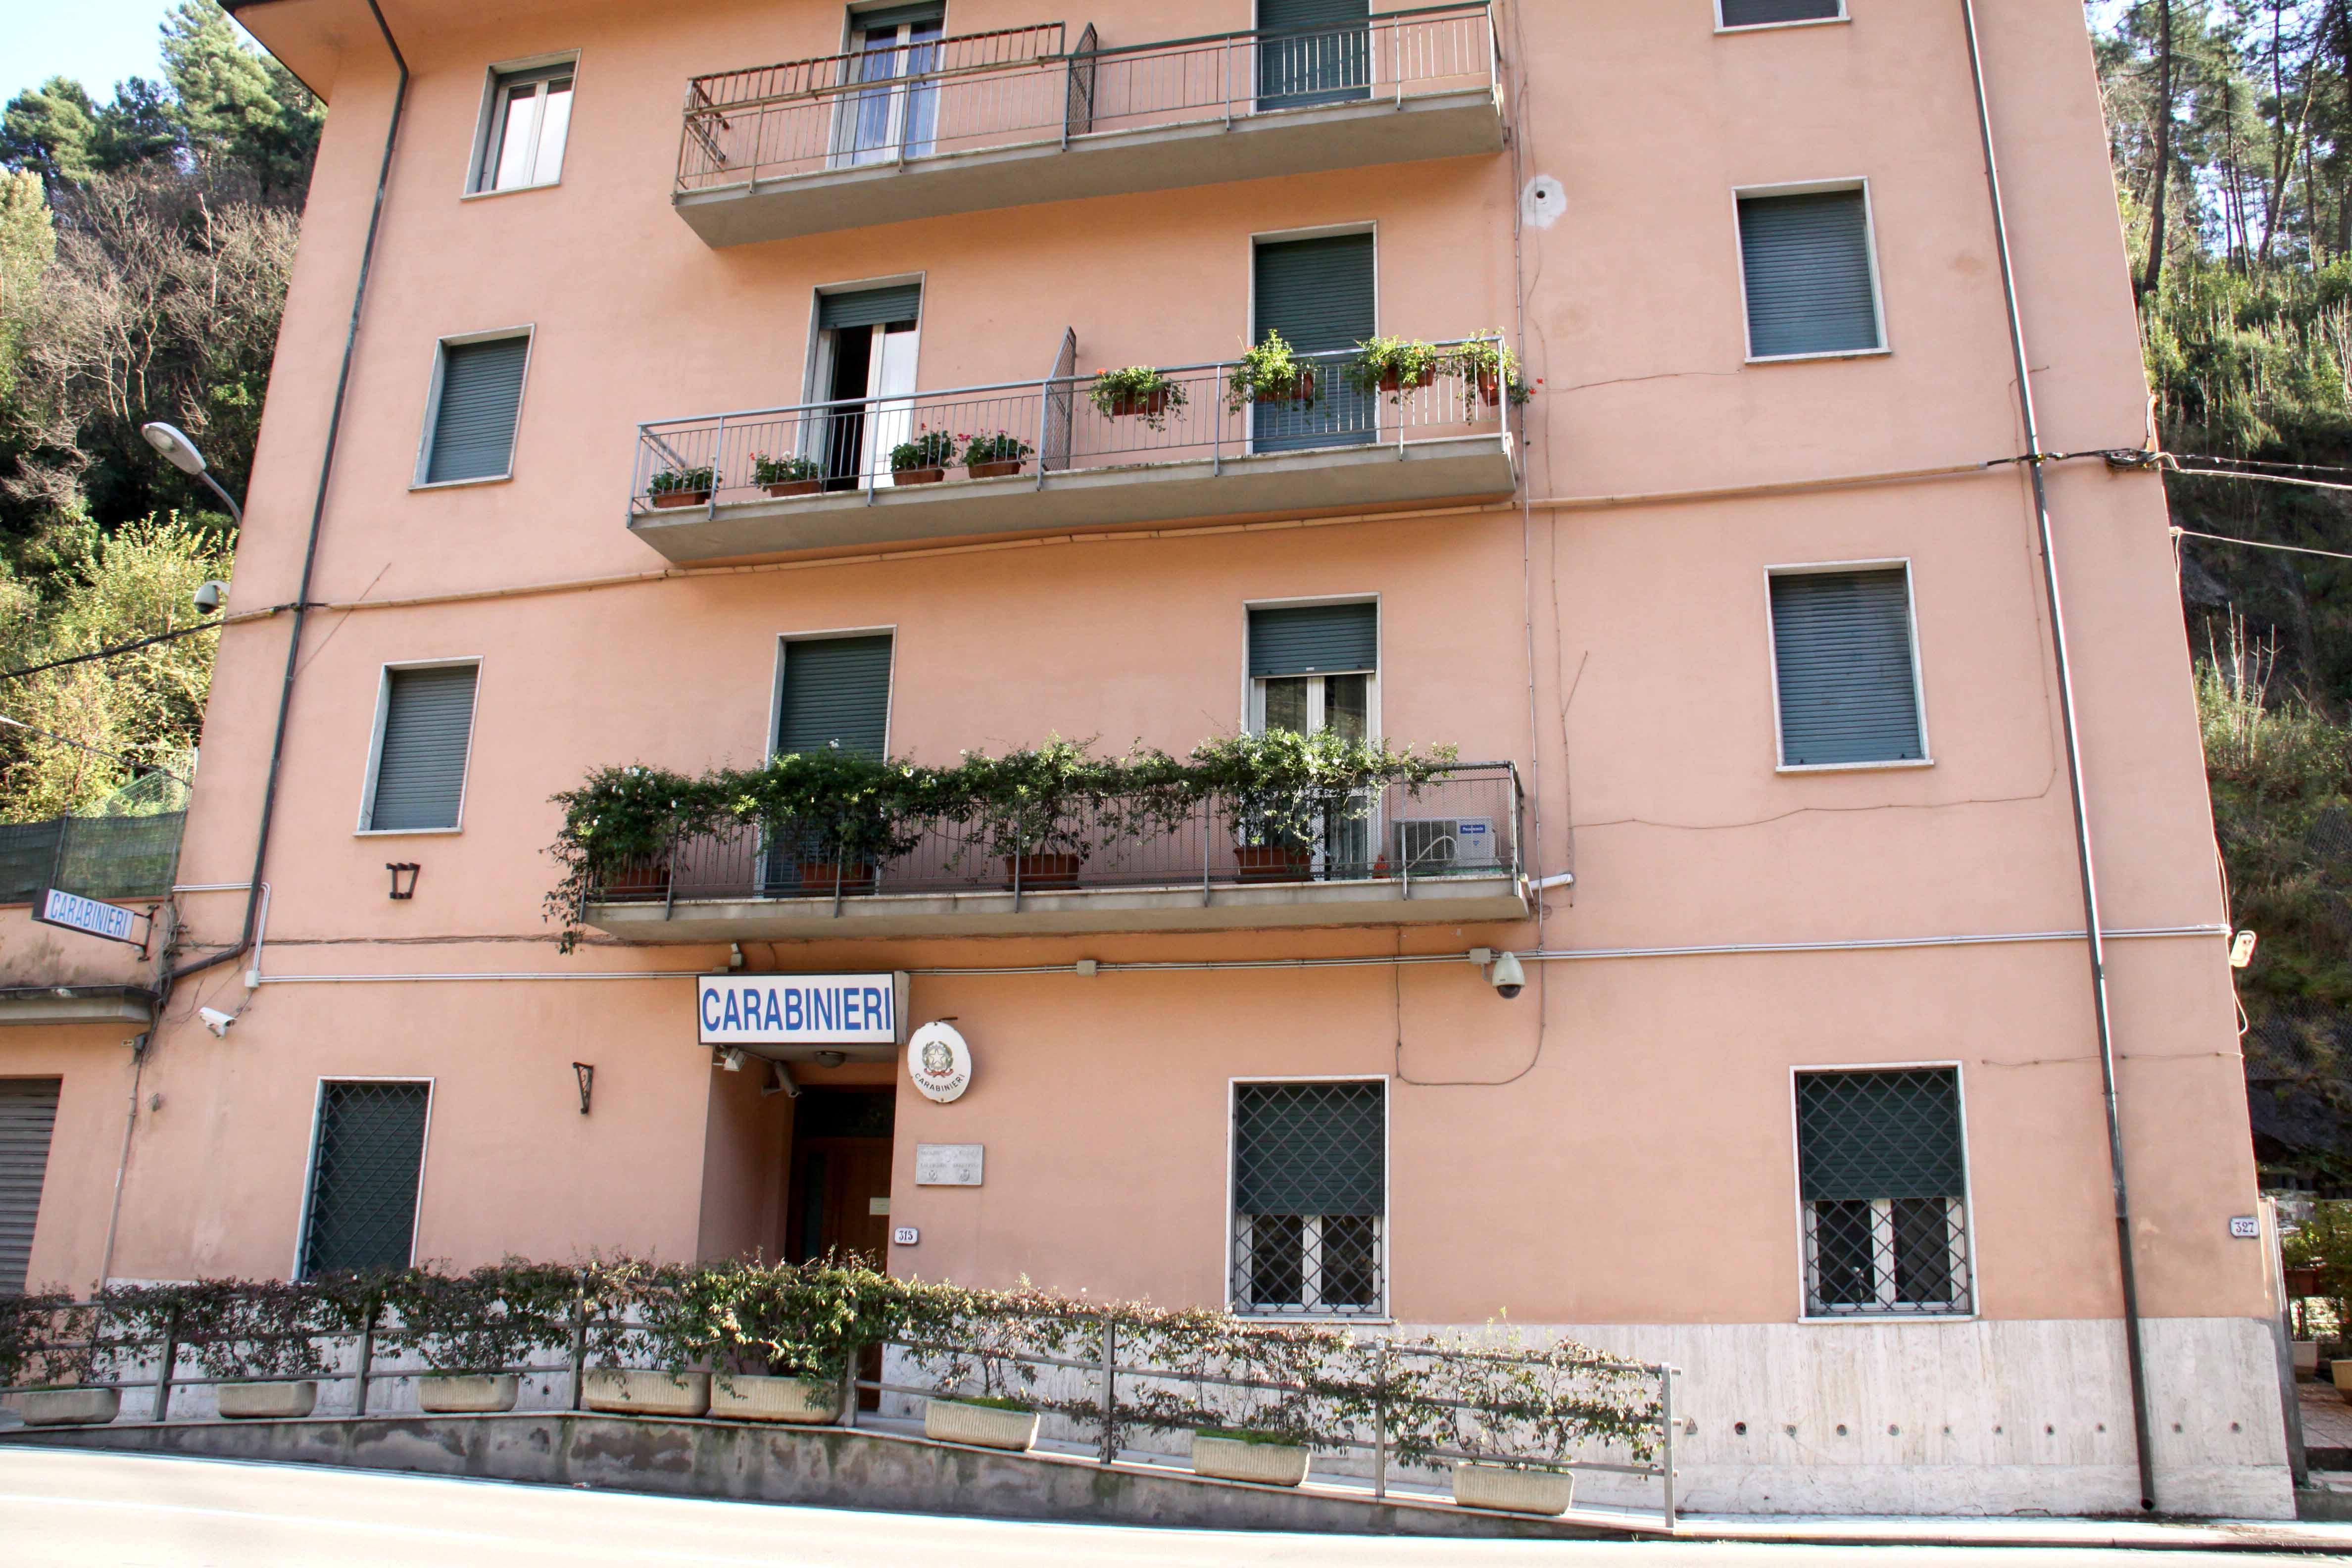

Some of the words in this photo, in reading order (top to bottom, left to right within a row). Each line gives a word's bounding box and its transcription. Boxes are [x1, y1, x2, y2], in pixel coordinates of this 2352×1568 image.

[50, 893, 128, 936] CARABINIERI
[702, 987, 891, 1031] CARABINIERI
[915, 1073, 965, 1091] CARABINIERI
[899, 1230, 913, 1240] 315
[2235, 1222, 2254, 1232] 327
